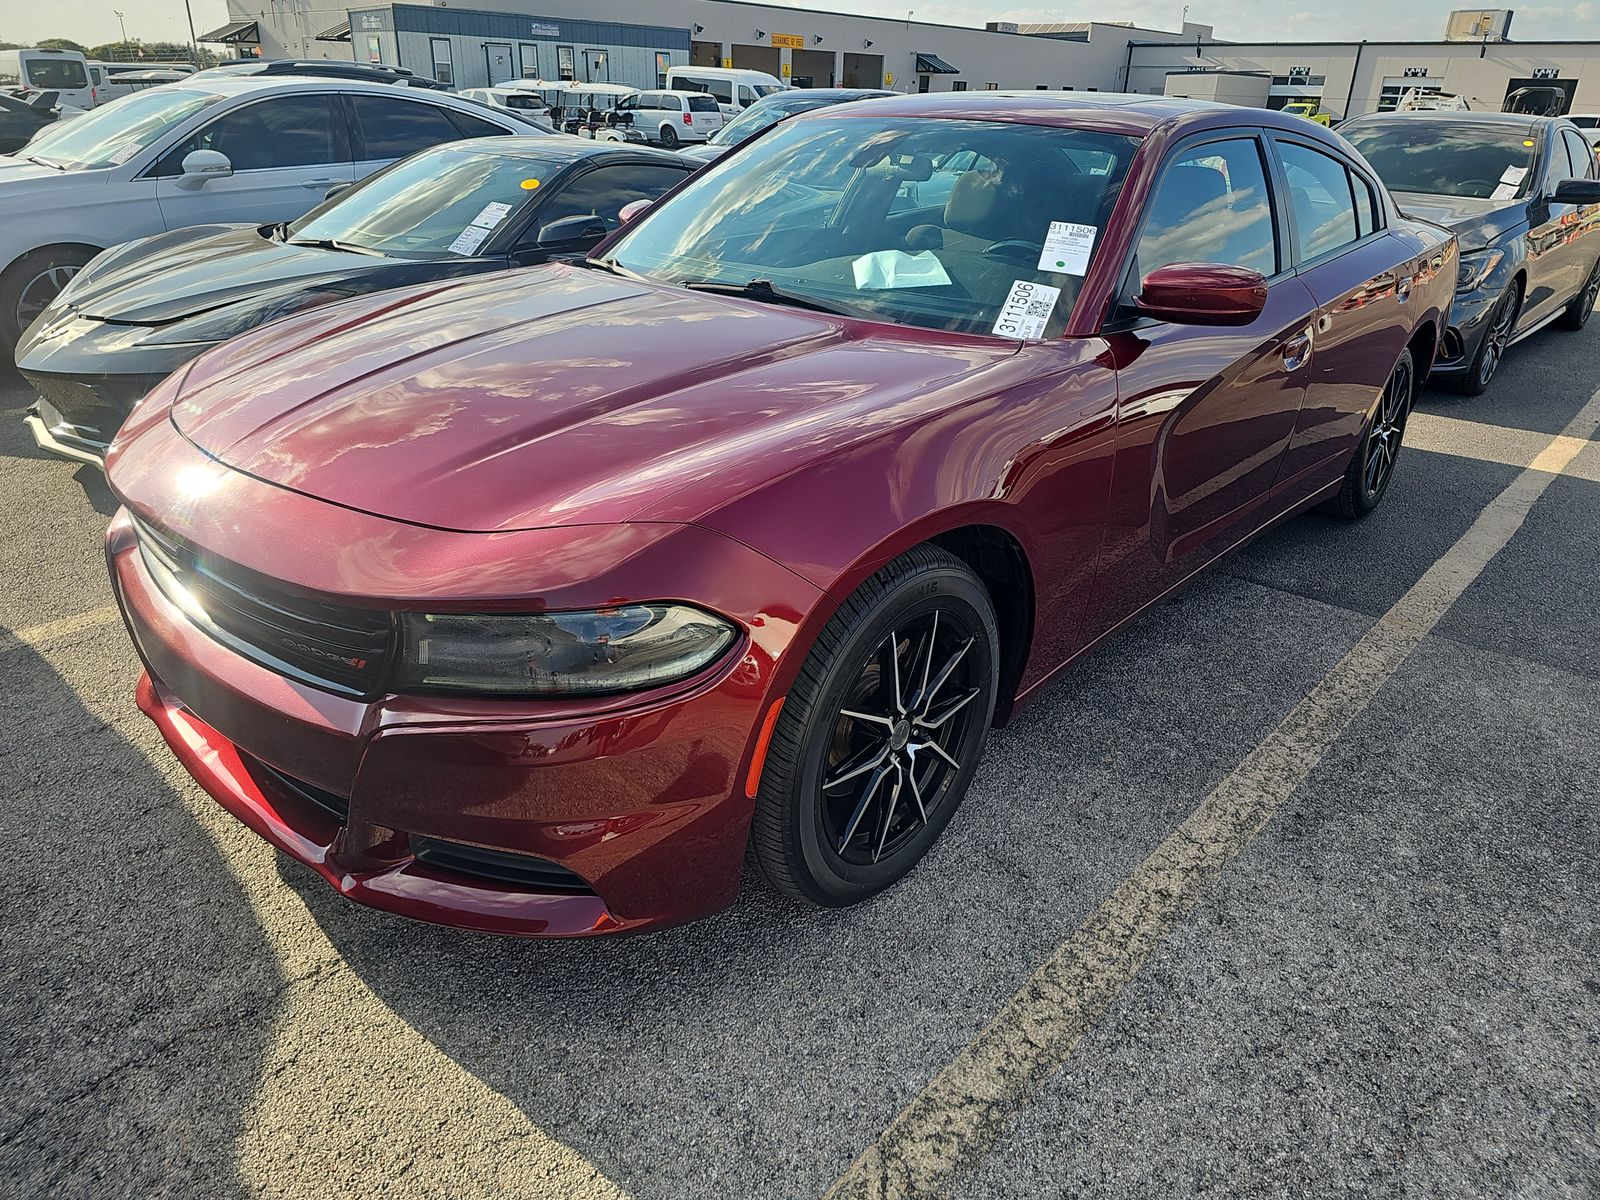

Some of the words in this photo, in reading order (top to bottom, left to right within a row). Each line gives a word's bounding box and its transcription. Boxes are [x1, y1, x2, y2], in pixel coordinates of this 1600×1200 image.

[453, 226, 476, 251] 3111477
[1050, 222, 1096, 235] 3111506
[999, 282, 1034, 333] 3111506
